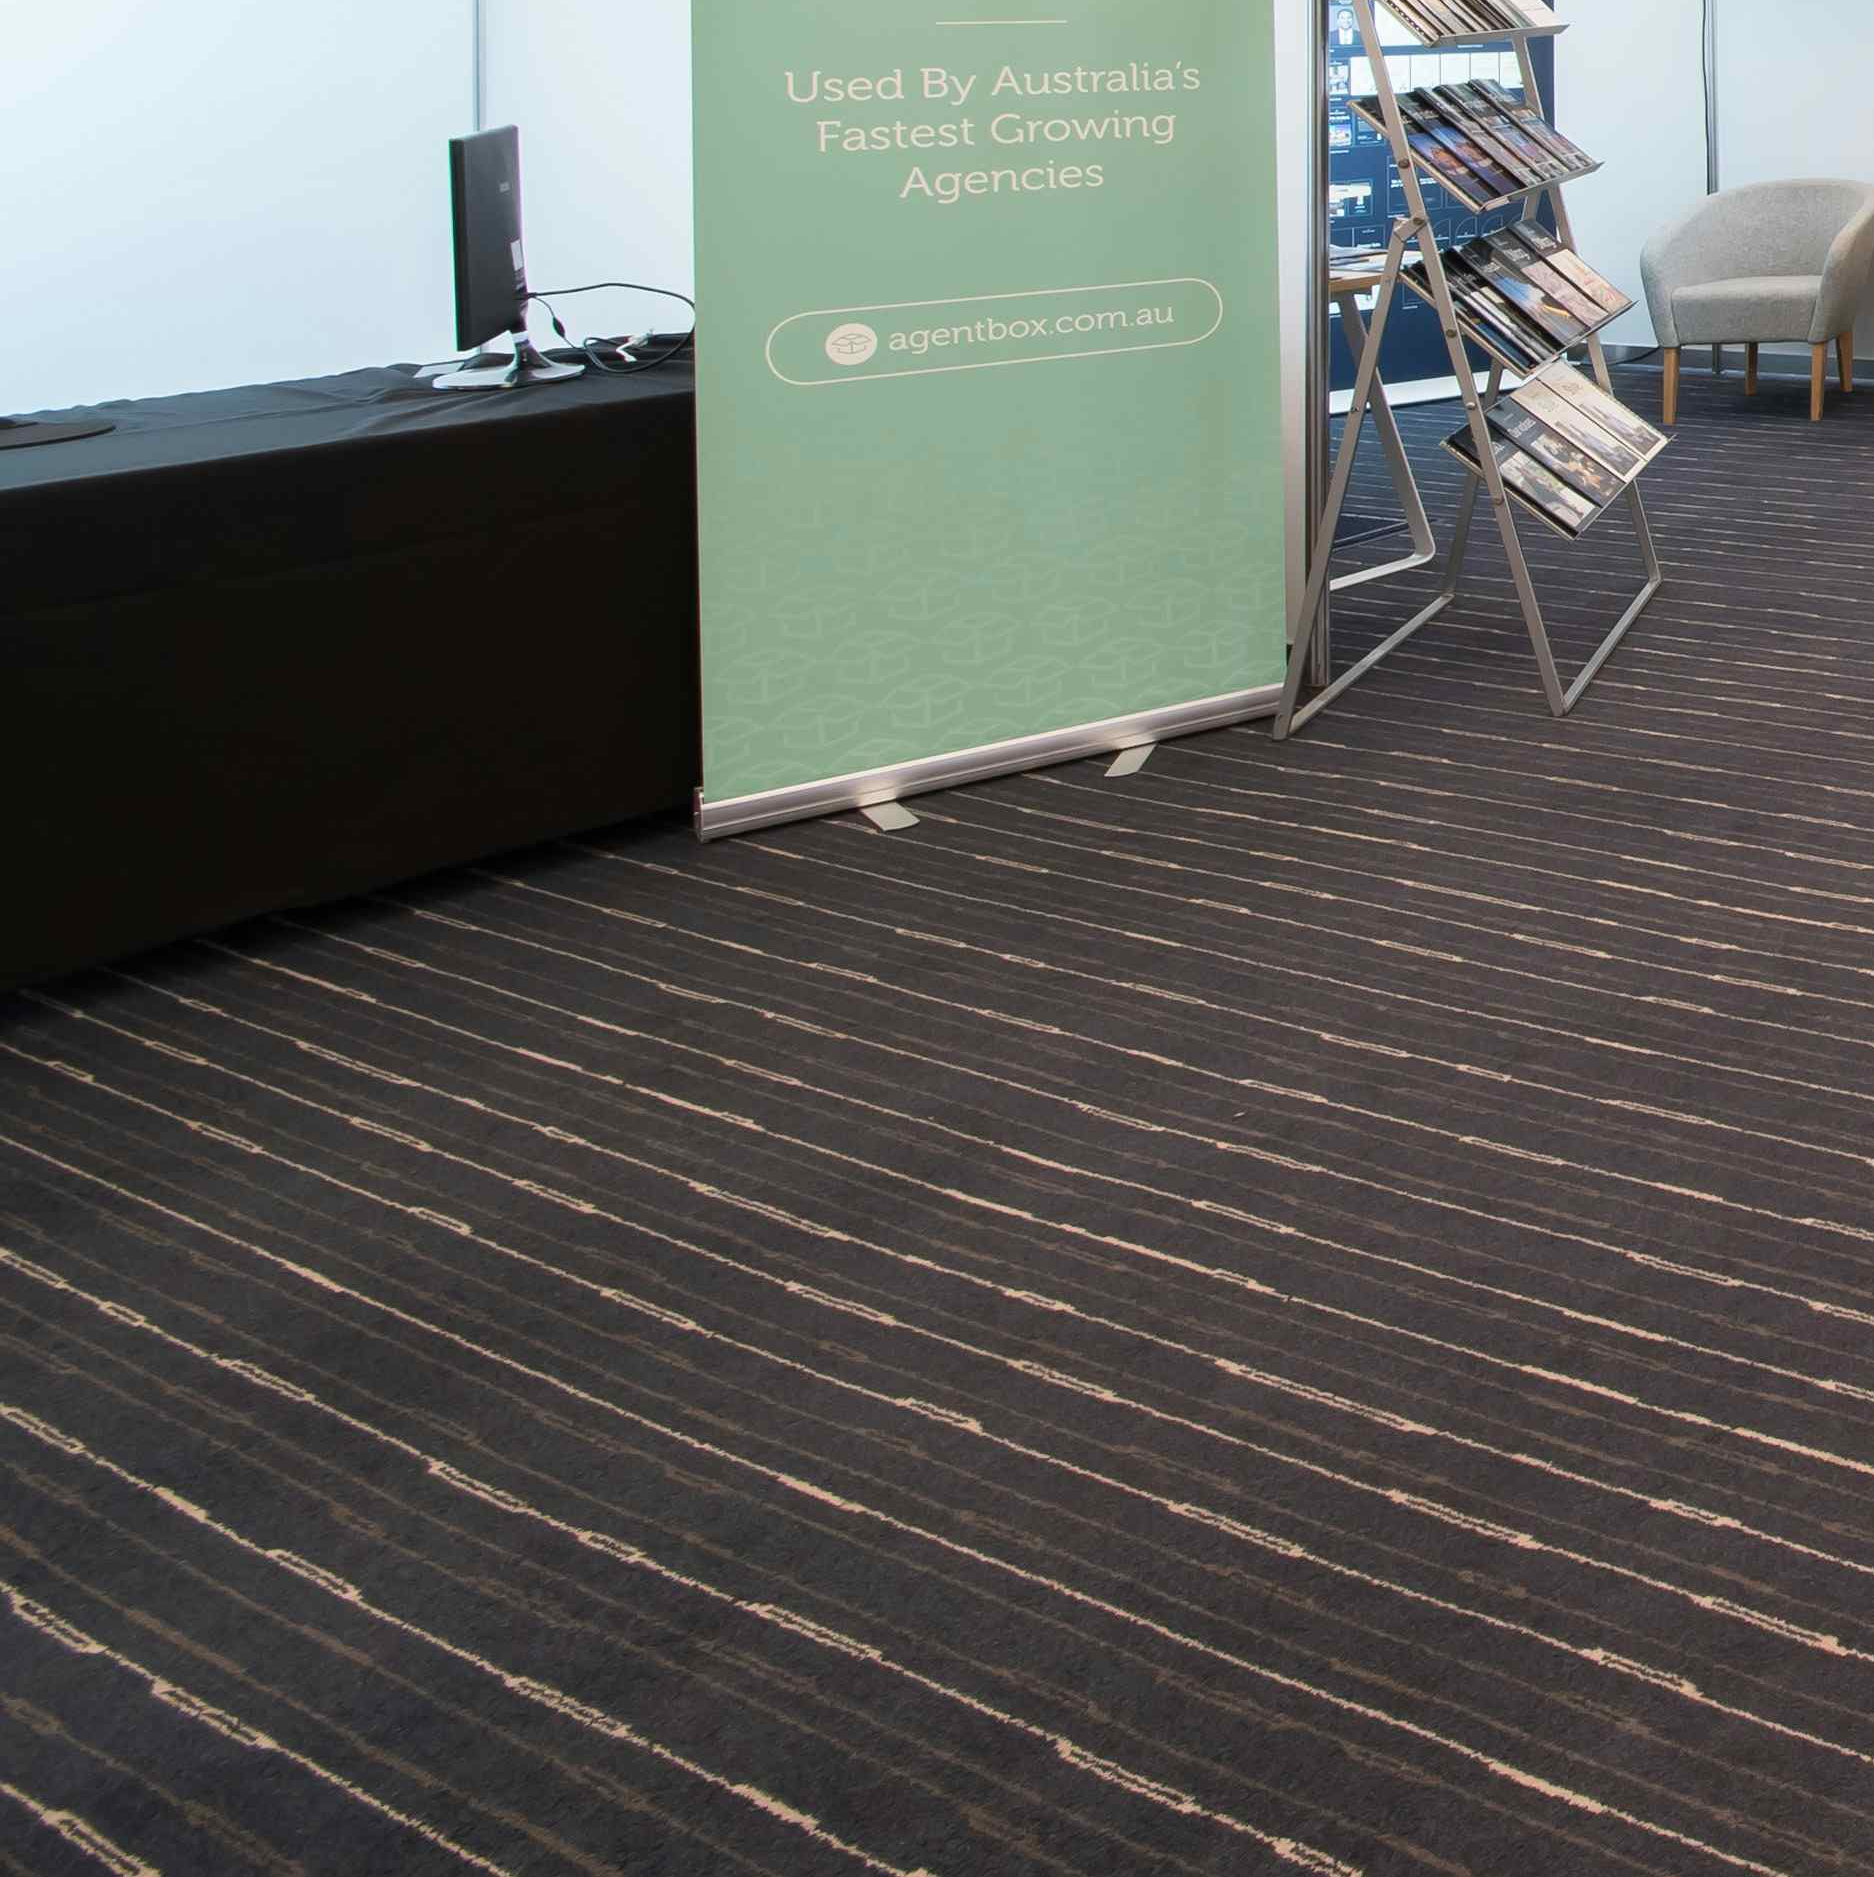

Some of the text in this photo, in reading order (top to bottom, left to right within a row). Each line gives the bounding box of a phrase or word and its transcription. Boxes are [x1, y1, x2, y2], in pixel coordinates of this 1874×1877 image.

[785, 61, 1200, 106] Used By Australia's
[818, 109, 1177, 152] Fastest Growing
[899, 160, 1104, 205] Agencies
[888, 300, 1174, 355] agentbox.com.au
